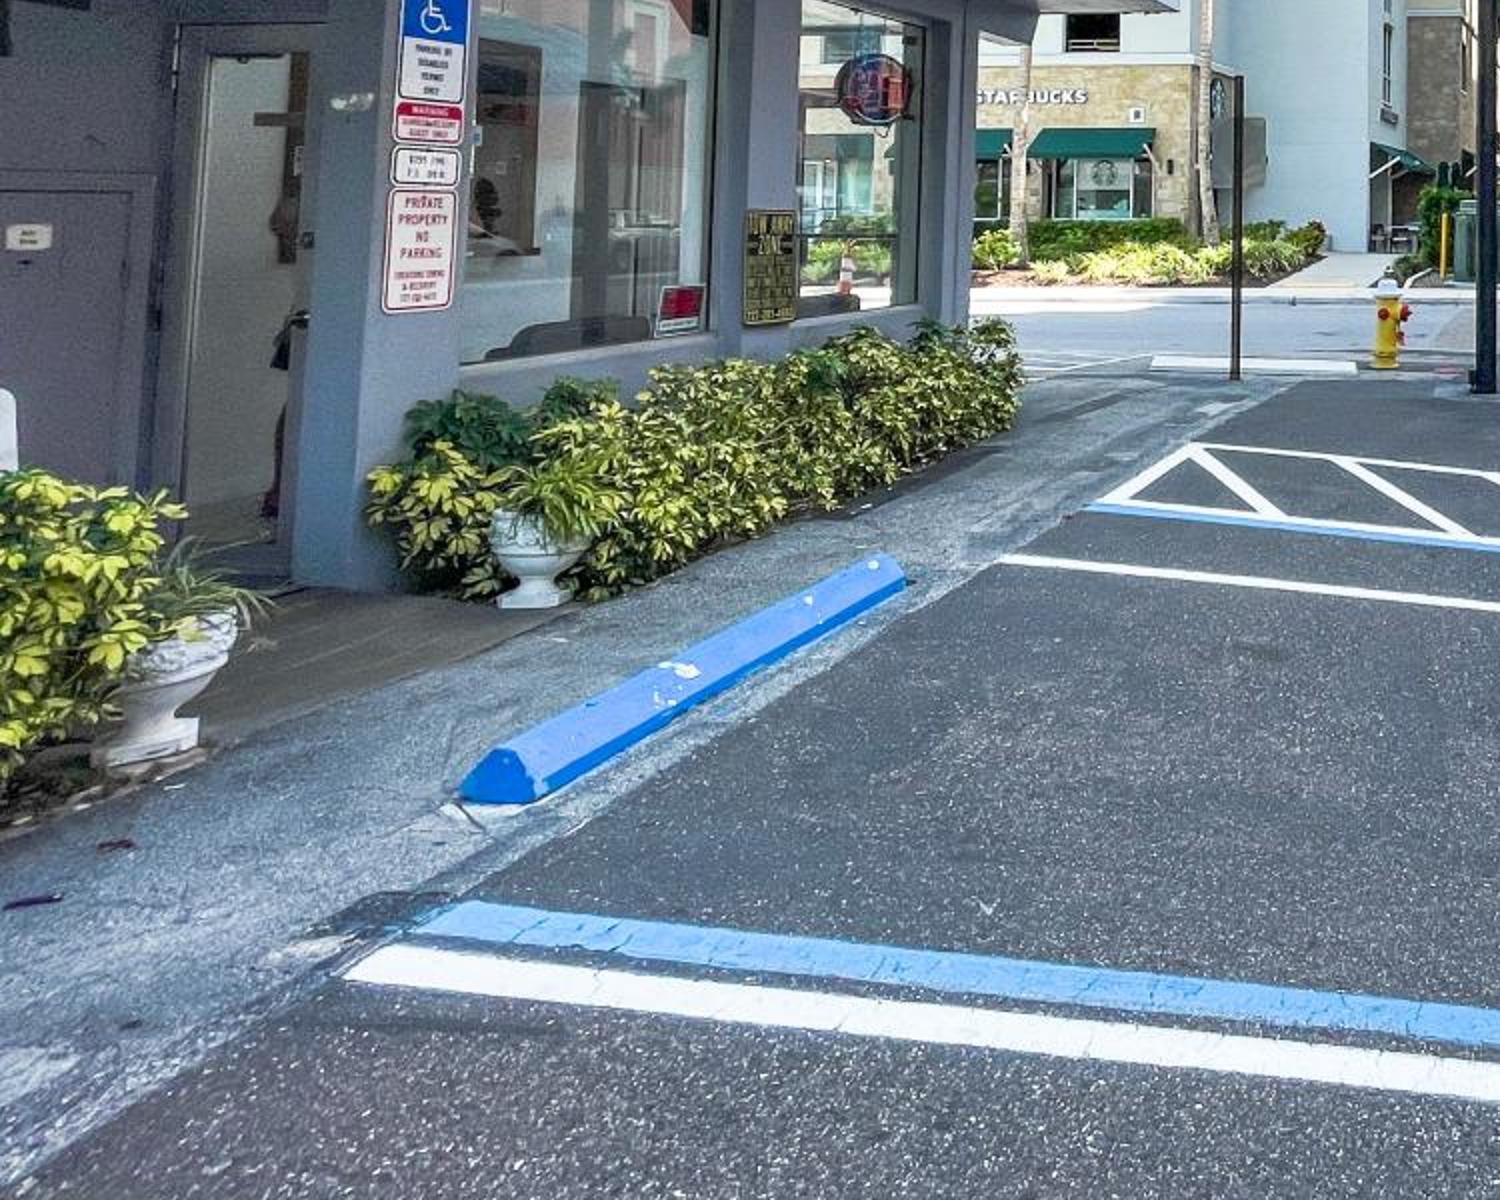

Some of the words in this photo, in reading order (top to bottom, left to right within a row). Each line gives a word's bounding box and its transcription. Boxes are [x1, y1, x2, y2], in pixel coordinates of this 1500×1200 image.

[405, 196, 444, 209] PRIVATE
[398, 213, 449, 226] PROPERTY
[415, 231, 429, 243] NO
[400, 247, 443, 259] PARKING
